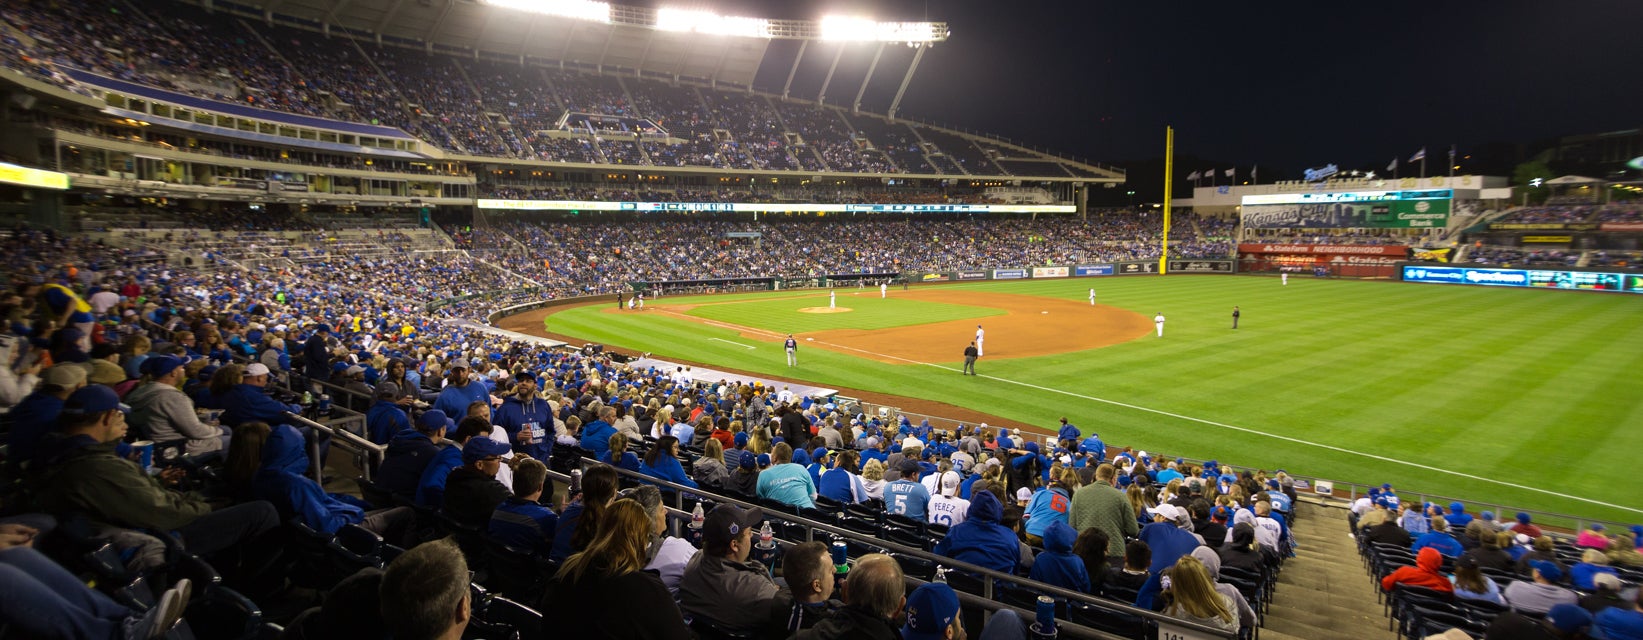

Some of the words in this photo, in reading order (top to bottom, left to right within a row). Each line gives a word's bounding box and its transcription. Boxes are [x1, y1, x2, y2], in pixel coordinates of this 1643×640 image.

[1400, 178, 1417, 188] 20
[1217, 185, 1230, 195] 42
[1243, 209, 1298, 228] Kansas
[1299, 203, 1329, 220] City
[1398, 212, 1446, 220] Commerce
[1410, 219, 1433, 227] Bank
[1313, 245, 1384, 253] NEIGHBORHOOD
[1348, 256, 1379, 266] State
[1465, 270, 1525, 284] Spectrum
[891, 483, 915, 493] BRETT
[894, 494, 908, 515] 5
[934, 502, 956, 514] PEREZ
[1050, 493, 1069, 514] 6
[907, 612, 917, 629] KC
